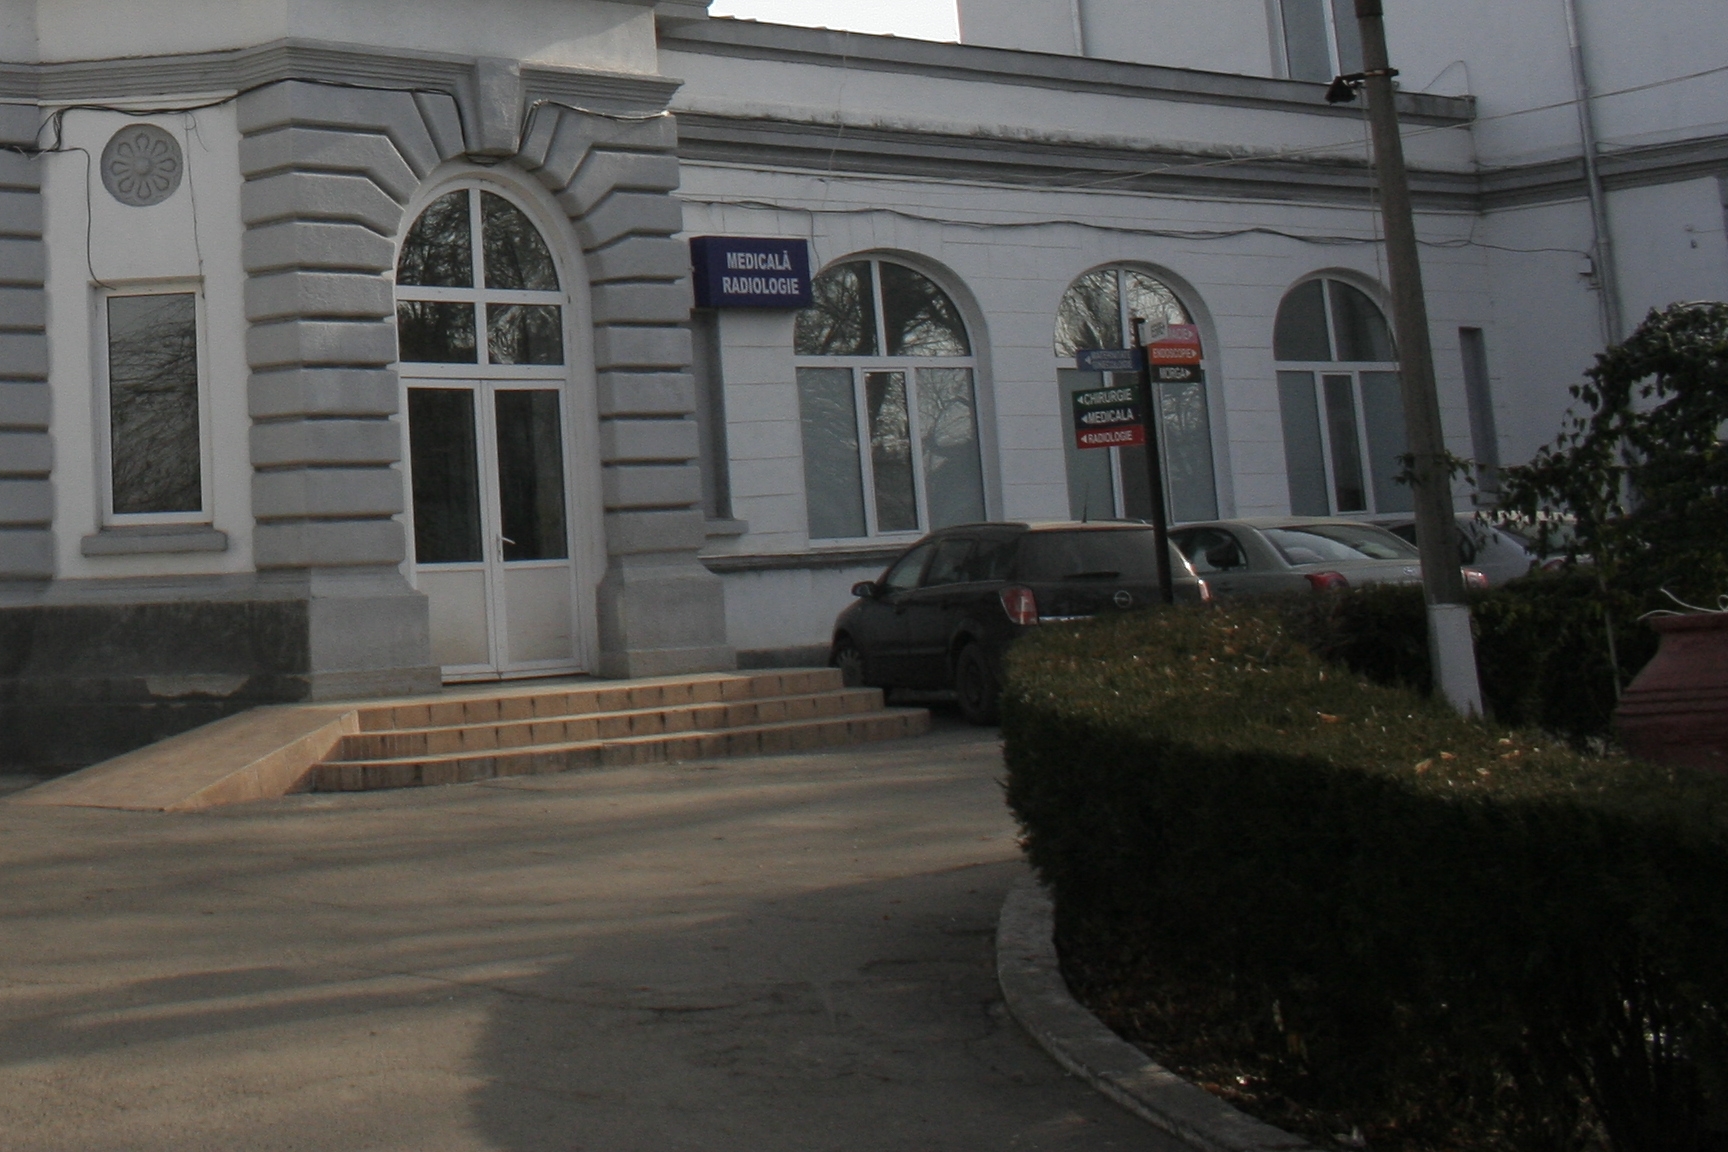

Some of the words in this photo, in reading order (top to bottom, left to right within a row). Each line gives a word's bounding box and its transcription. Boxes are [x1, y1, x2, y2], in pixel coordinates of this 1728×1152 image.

[726, 250, 792, 271] MEDICALĂ
[722, 276, 800, 295] RADIOLOGIE
[1083, 389, 1132, 406] CHIRURGIE
[1087, 430, 1133, 444] RADIOLOGIE
